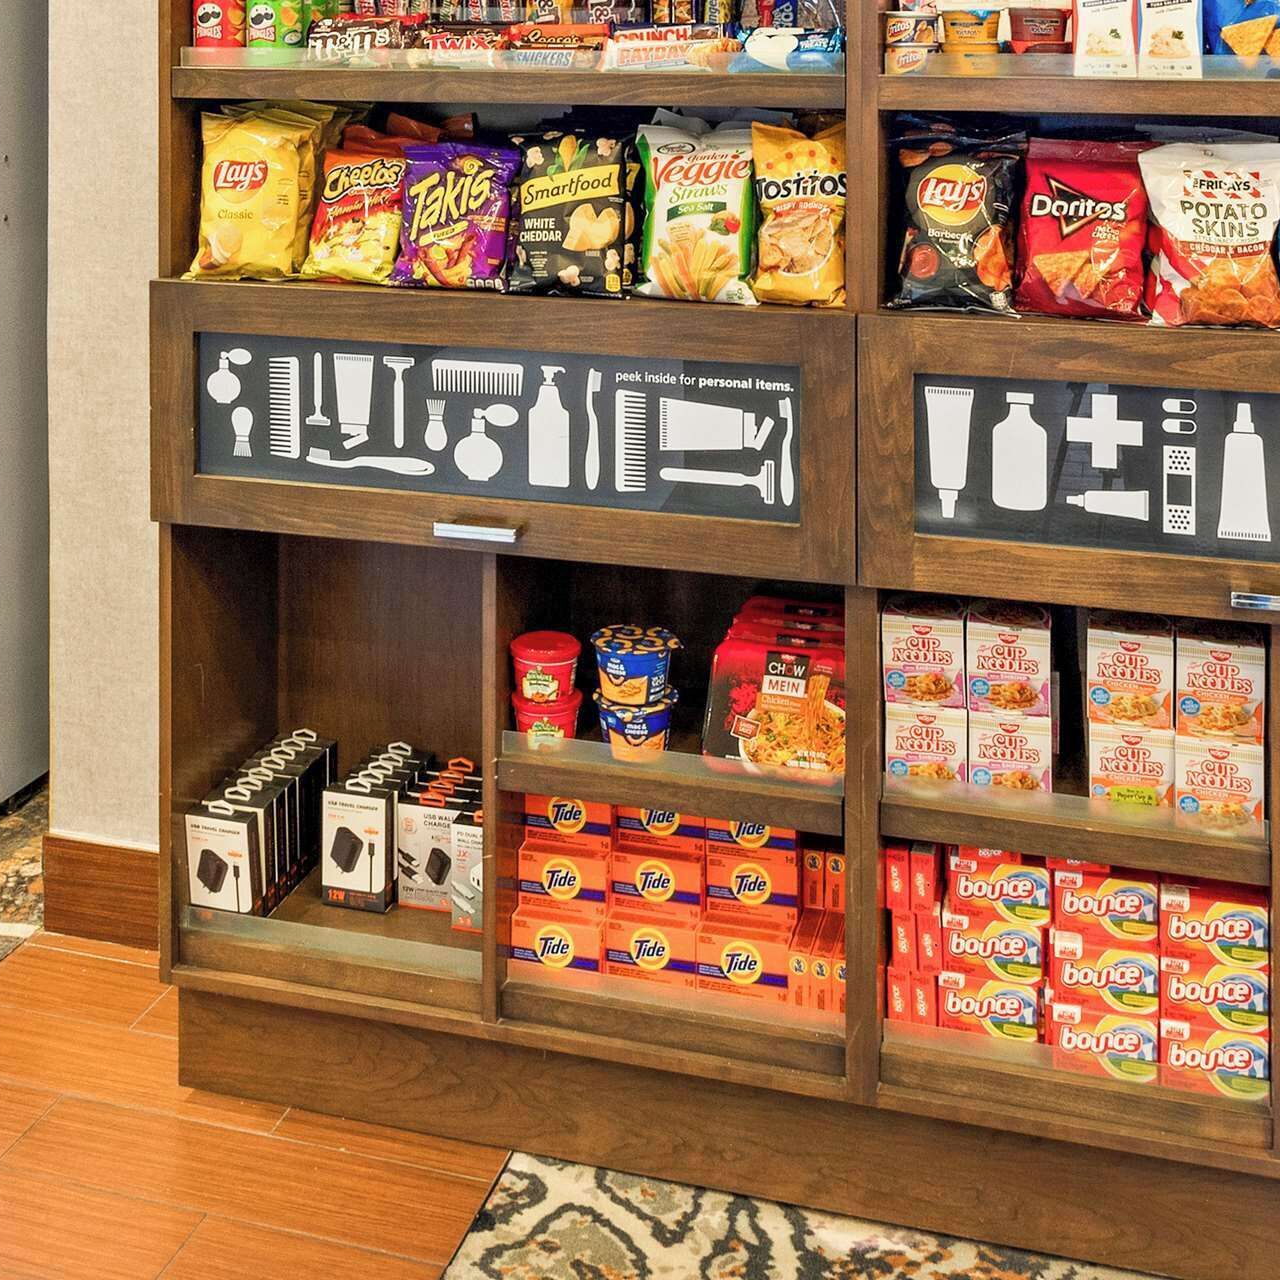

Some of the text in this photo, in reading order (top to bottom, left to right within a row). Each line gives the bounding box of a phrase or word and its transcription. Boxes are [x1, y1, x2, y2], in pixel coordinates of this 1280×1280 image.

[196, 24, 223, 40] PRINGLES
[248, 24, 276, 41] PRINGLES
[516, 51, 573, 67] SNICKERS
[618, 44, 689, 65] PAYDAY
[215, 160, 266, 191] Lay's
[322, 159, 401, 201] Cheetos
[652, 157, 753, 191] Veggie
[523, 172, 613, 206] Smartfood
[669, 183, 728, 204] Straws
[756, 170, 847, 202] TOSTITOS
[922, 177, 985, 212] Lay's
[218, 208, 253, 221] Classic
[410, 167, 495, 241] Takis
[677, 202, 715, 215] Sea Salt
[1031, 193, 1127, 220] Doritos
[1180, 200, 1268, 221] POTATO
[524, 217, 556, 230] WHITE
[1190, 218, 1261, 238] SKINS
[520, 230, 562, 243] CHEDDAR
[1189, 243, 1265, 255] CHEDDAR & BACON
[615, 371, 795, 392] peek inside for personal items.
[906, 637, 941, 650] CUP
[991, 645, 1027, 658] CUP
[893, 648, 953, 665] NOODLES
[977, 655, 1039, 674] NOODLES
[1112, 652, 1149, 667] CUP
[768, 662, 805, 677] CHOW
[1097, 663, 1161, 684] NOODLES
[1202, 662, 1240, 678] CUP
[768, 679, 800, 693] MEIN
[1187, 673, 1253, 695] NOODLES
[910, 725, 944, 739] CUP
[992, 734, 1028, 748] CUP
[896, 738, 956, 755] NOODLES
[978, 745, 1040, 763] NOODLES
[1114, 746, 1151, 761] CUP
[1100, 757, 1164, 777] NOODLES
[1201, 760, 1239, 776] CUP
[1185, 772, 1252, 792] NOODLES
[551, 803, 582, 825] Tide
[546, 869, 576, 889] Tide
[640, 872, 670, 892] Tide
[734, 874, 767, 895] Tide
[958, 874, 1034, 901] bounce
[1063, 891, 1143, 917] bounce
[1169, 914, 1253, 942] bounce
[539, 936, 570, 957] Tide
[634, 939, 666, 961] Tide
[950, 931, 1027, 959] bounce
[724, 953, 757, 974] Tide
[1063, 960, 1143, 988] bounce
[1169, 976, 1252, 1006] bounce
[945, 991, 1021, 1019] bounce
[1060, 1026, 1141, 1053] bounce
[1169, 1042, 1252, 1071] bounce
